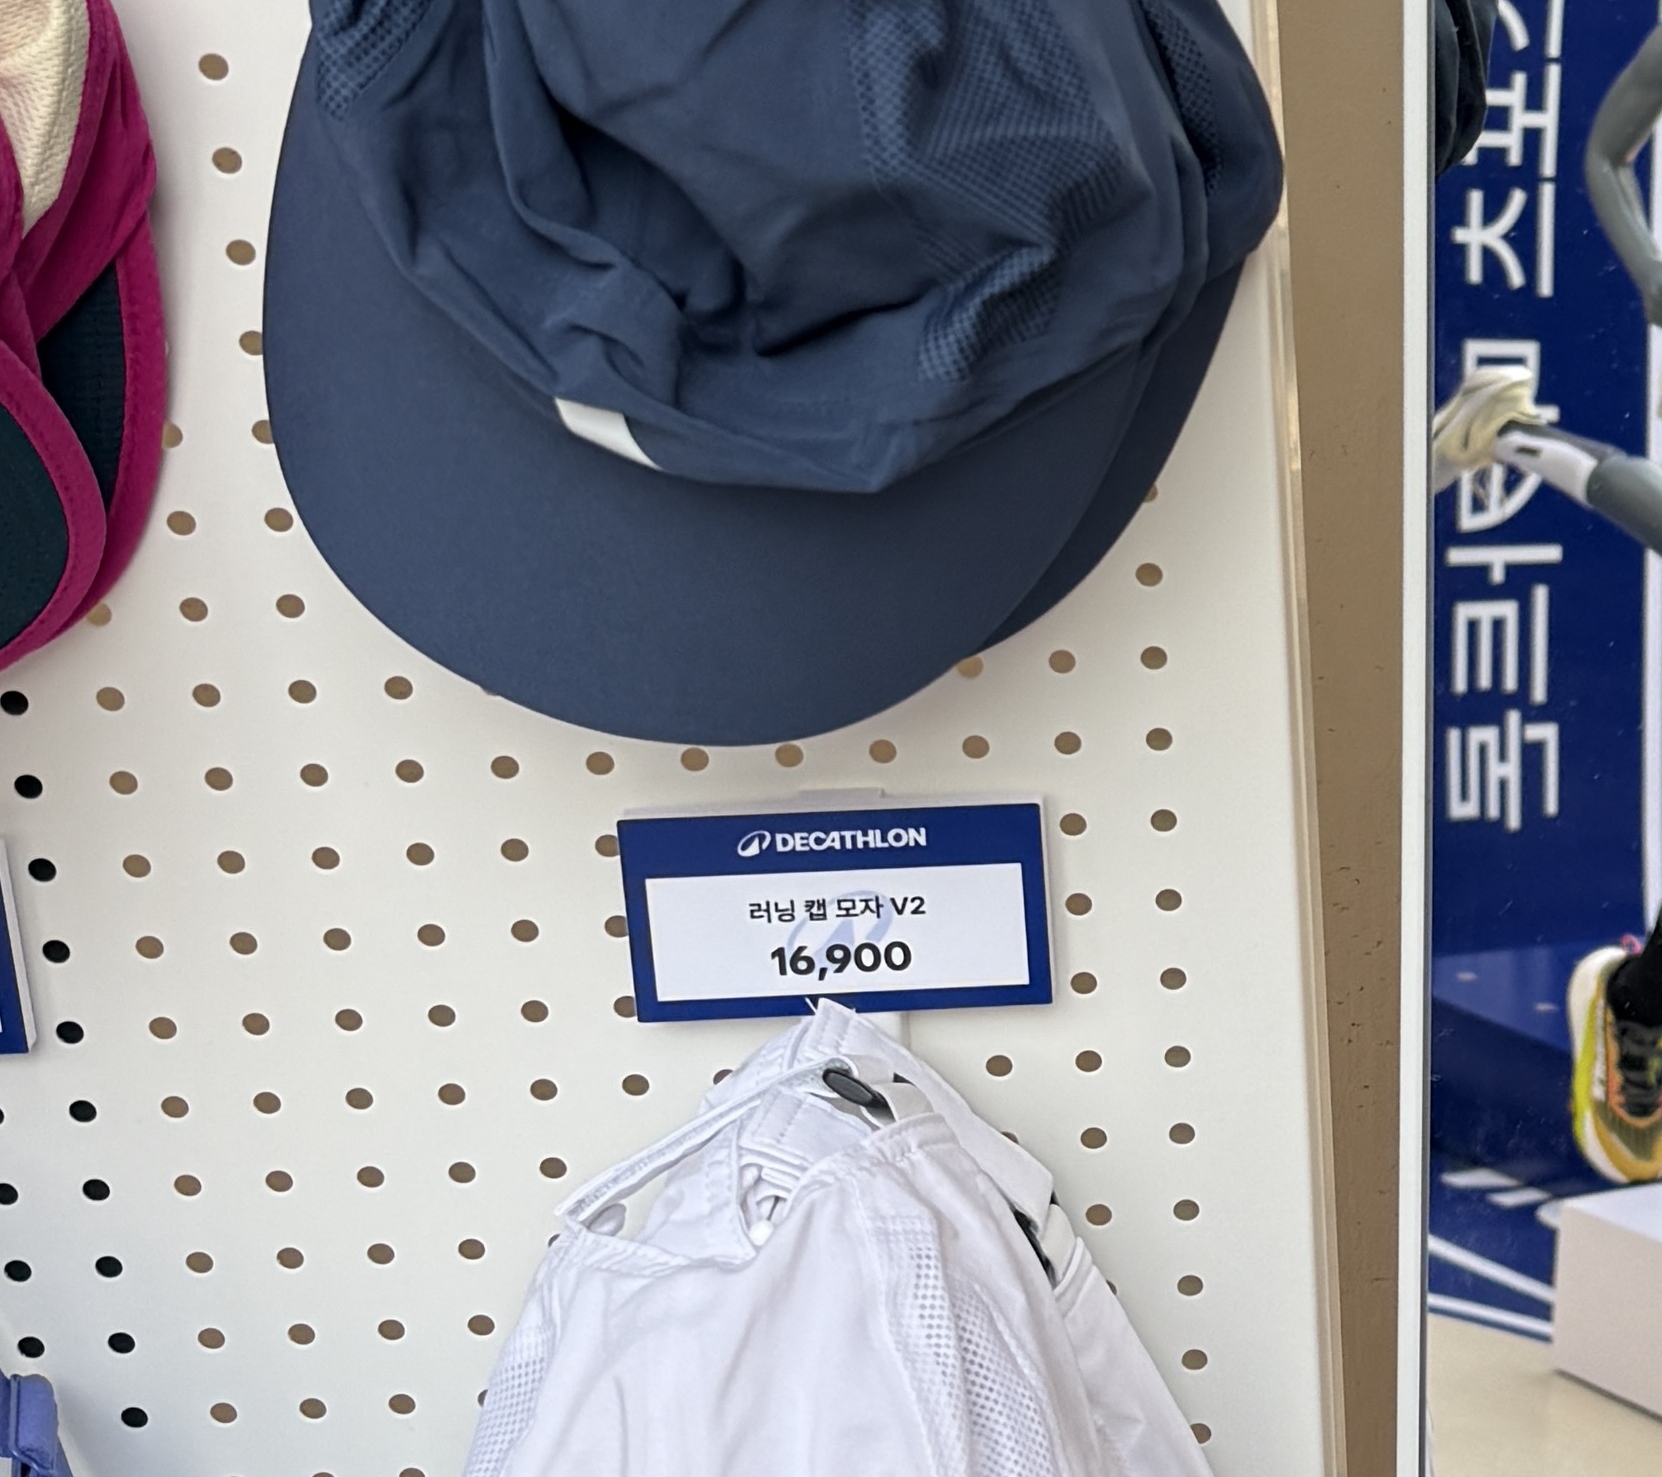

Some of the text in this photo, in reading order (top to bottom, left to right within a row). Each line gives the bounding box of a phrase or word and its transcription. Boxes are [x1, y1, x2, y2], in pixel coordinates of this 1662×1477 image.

[775, 827, 927, 853] DECATHLON
[748, 896, 926, 924] 러닝 캡 모자 V2
[770, 941, 912, 981] 16,900
